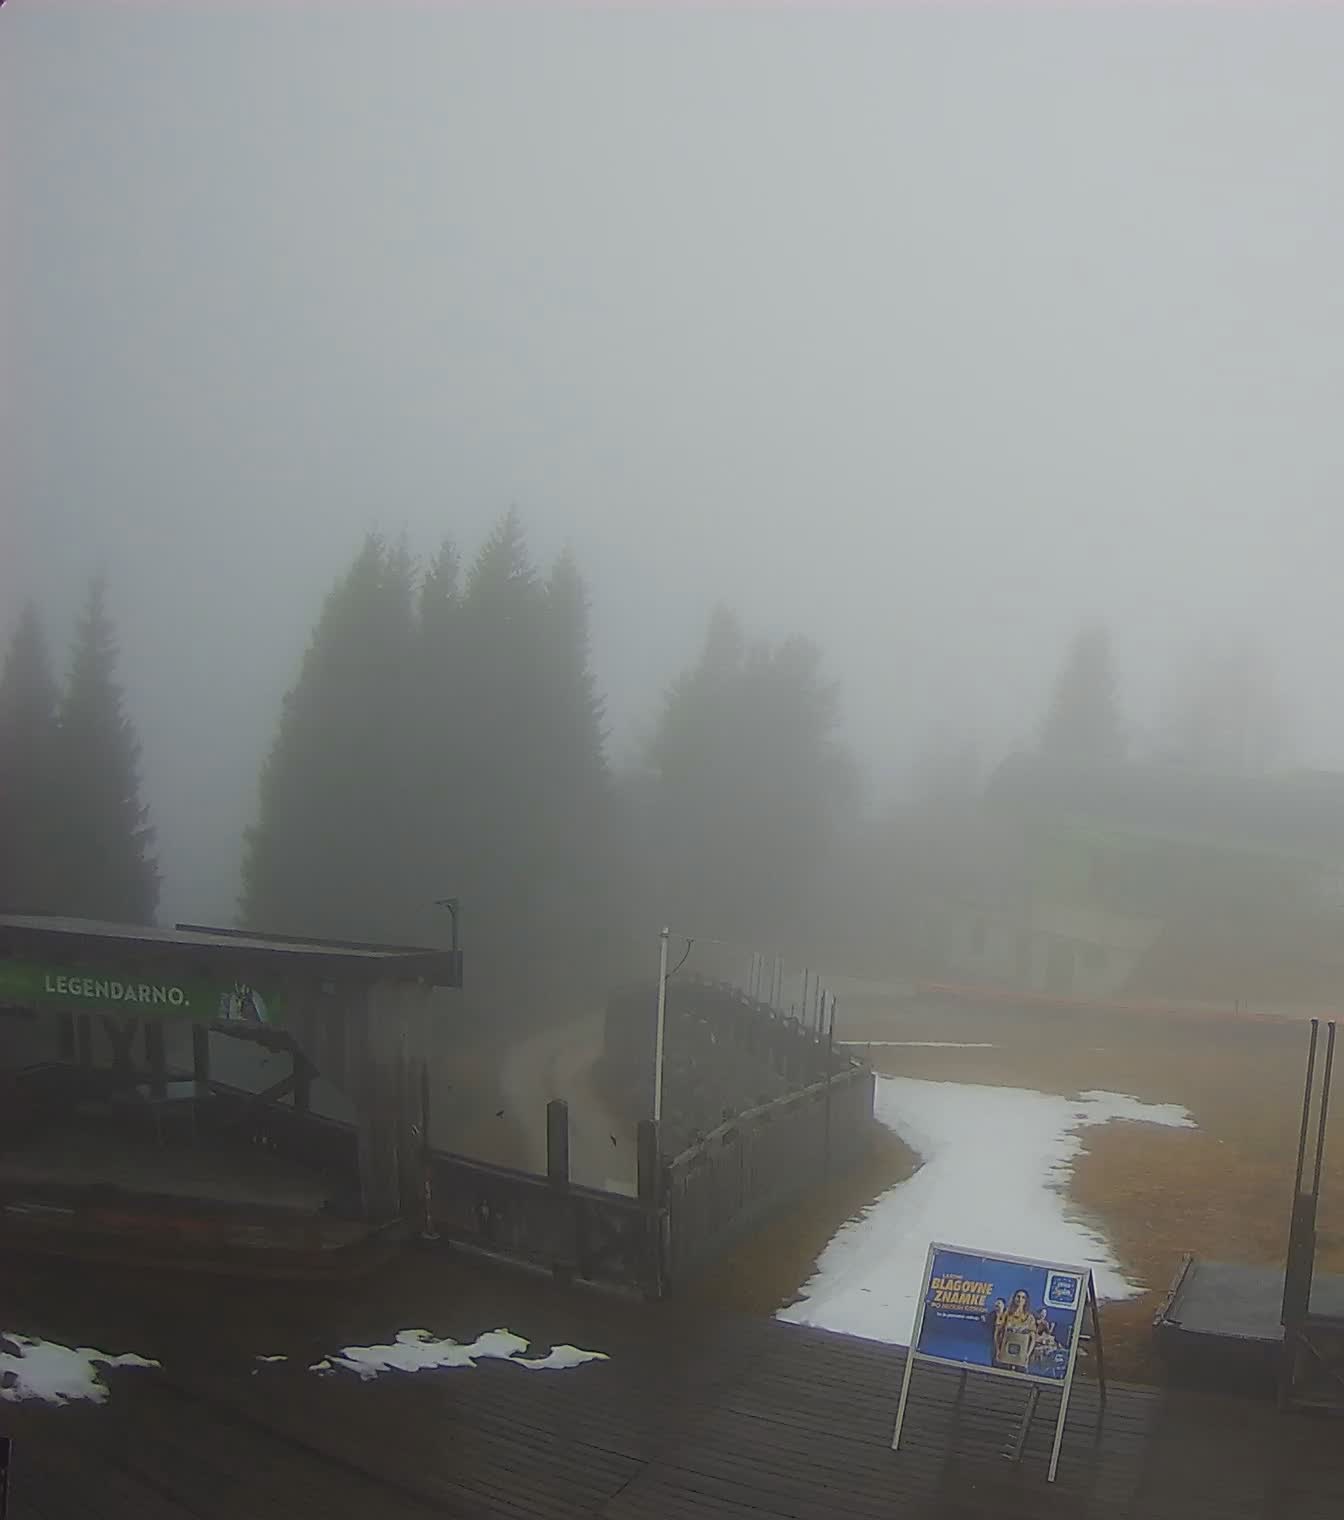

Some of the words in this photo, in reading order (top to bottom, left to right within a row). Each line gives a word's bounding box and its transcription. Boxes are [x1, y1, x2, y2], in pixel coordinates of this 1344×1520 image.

[45, 975, 190, 1006] LEGENDARNO.
[931, 1277, 994, 1295] BLAGOVNE
[934, 1290, 987, 1306] ZNAMKE
